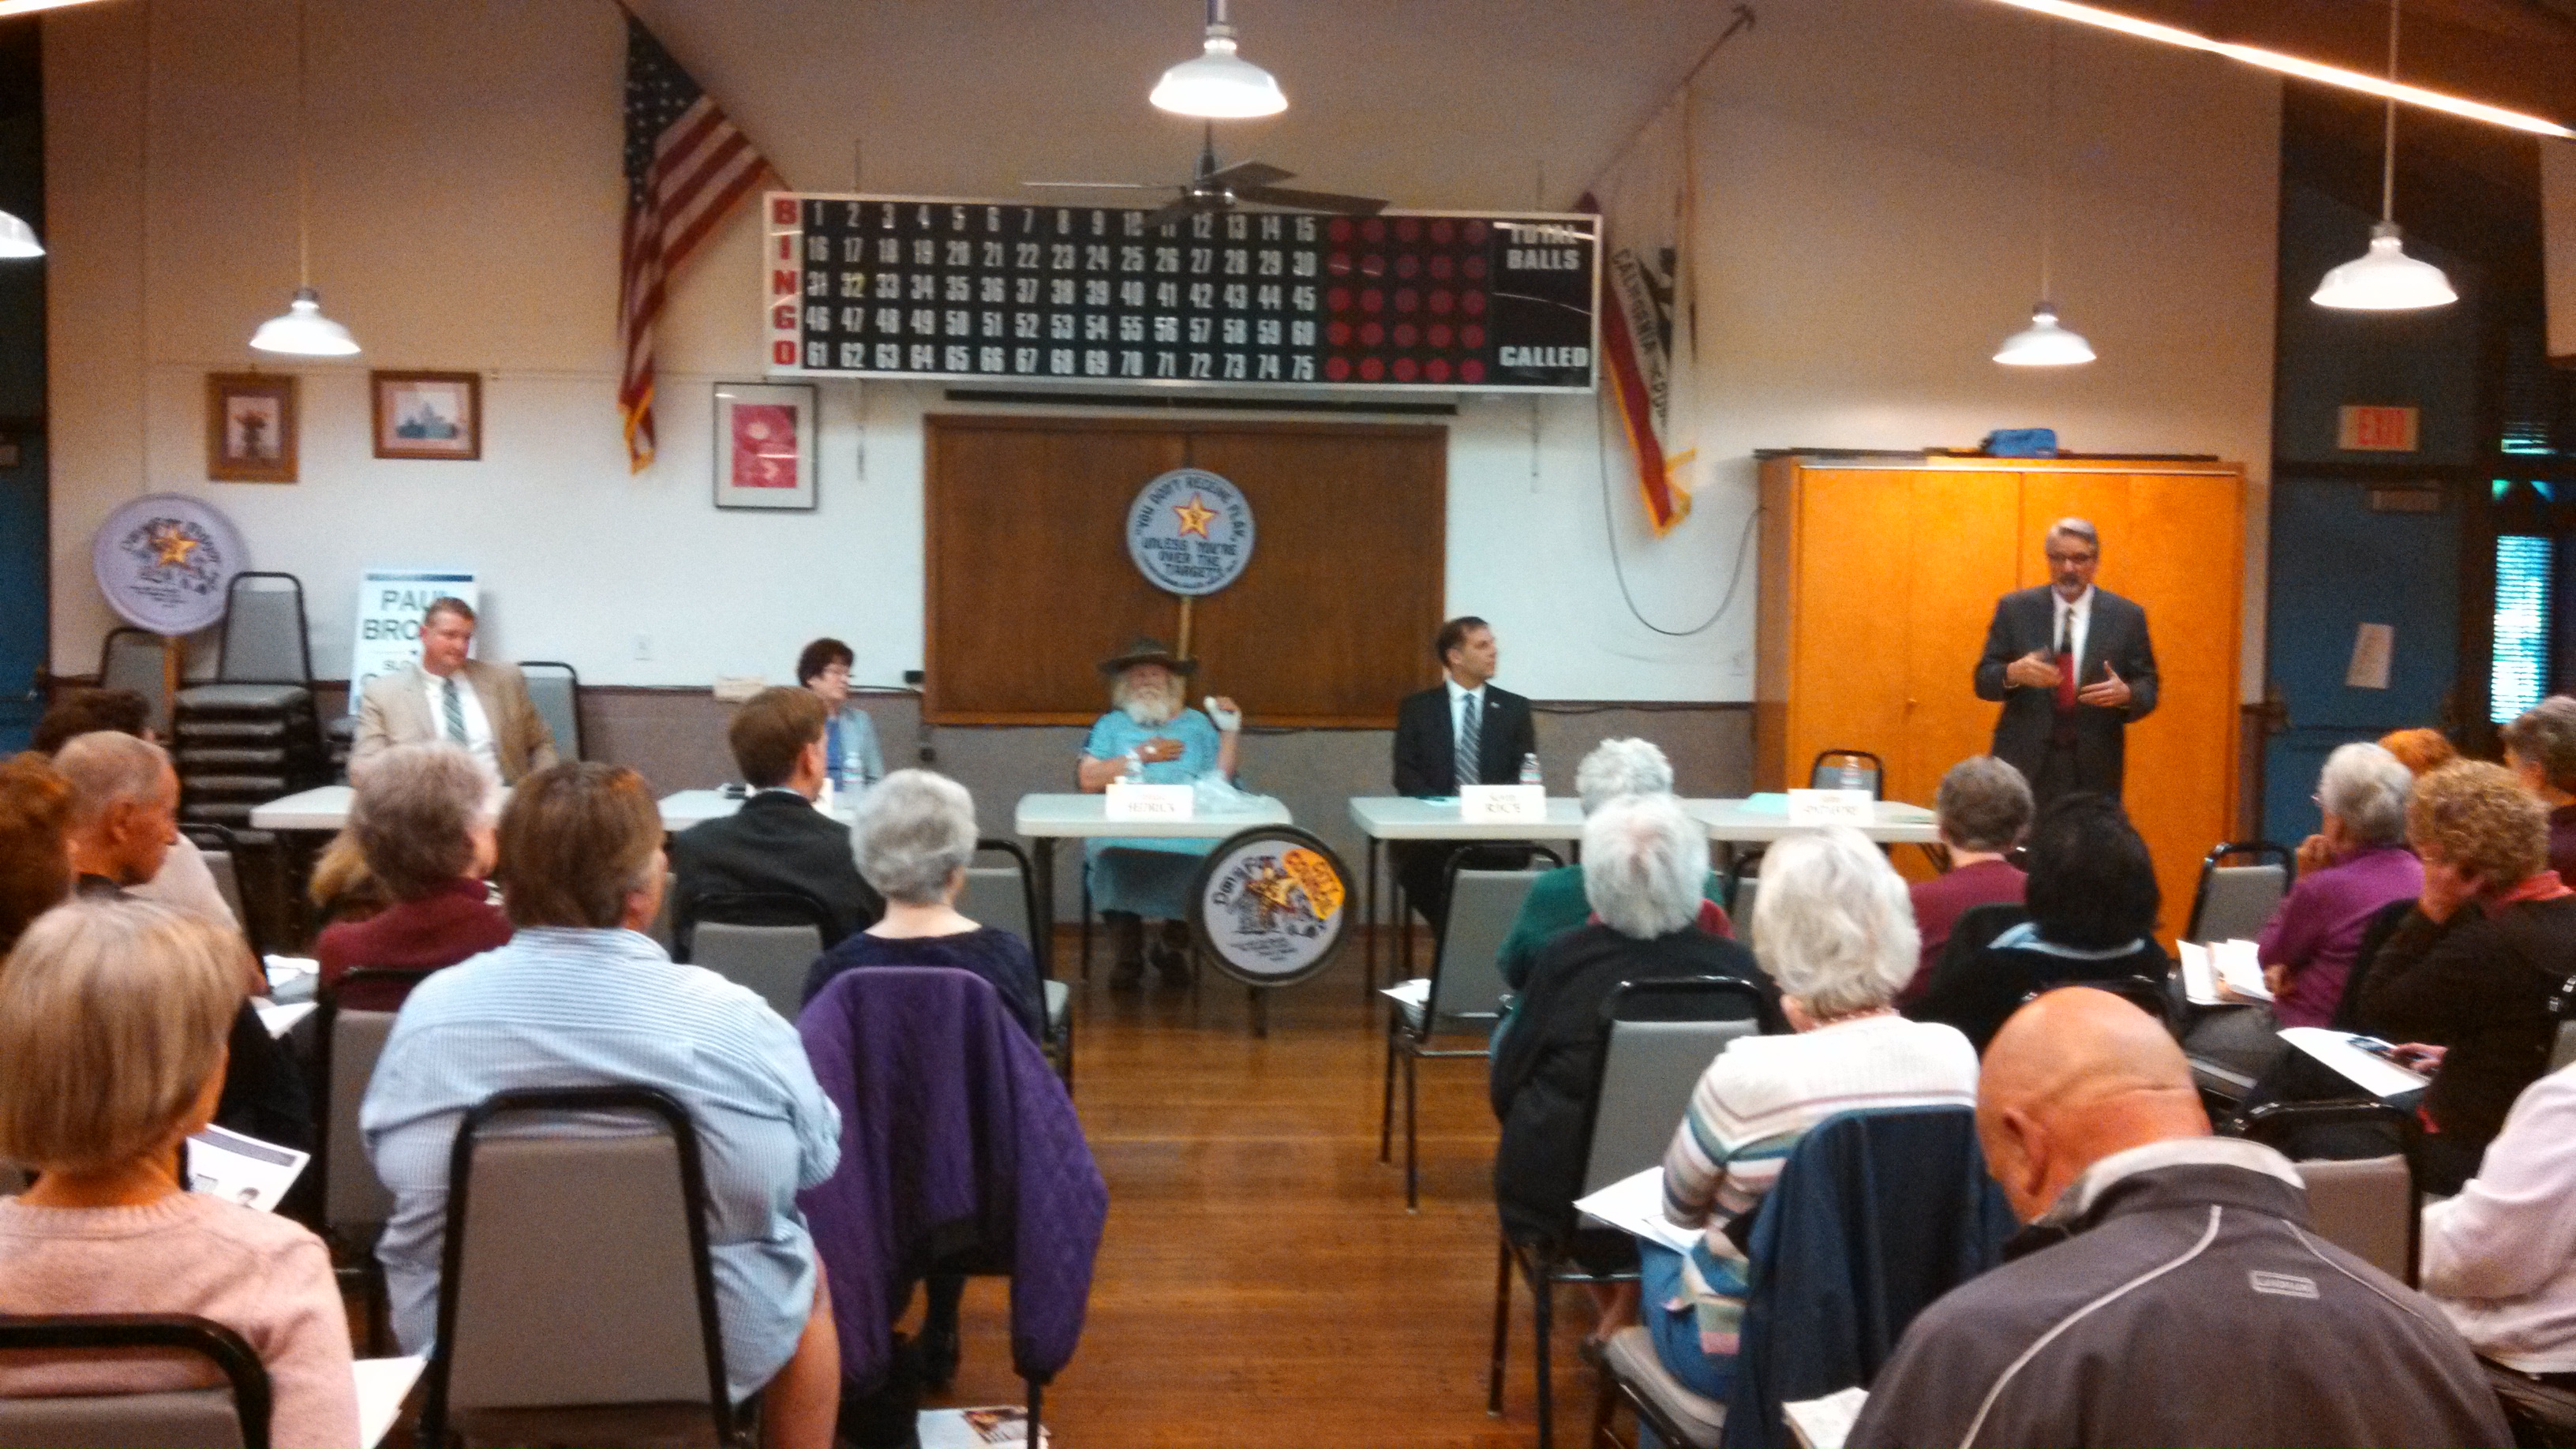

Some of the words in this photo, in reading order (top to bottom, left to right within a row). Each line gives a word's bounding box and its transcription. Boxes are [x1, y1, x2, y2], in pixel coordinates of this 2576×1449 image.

[807, 236, 829, 262] 16
[844, 237, 863, 262] 17
[879, 238, 899, 264] 18
[914, 240, 934, 264] 19
[947, 241, 970, 265] 20
[983, 242, 1003, 267] 21
[1017, 242, 1039, 268] 22
[1052, 244, 1075, 270] 23
[1087, 245, 1109, 270] 24
[1121, 246, 1144, 271] 25
[1156, 247, 1178, 272] 26
[1191, 248, 1212, 274] 27
[1225, 249, 1247, 275] 28
[1260, 250, 1282, 275] 29
[1293, 251, 1316, 277] 30
[1507, 249, 1581, 270] BALLS
[807, 271, 828, 298] 31
[841, 272, 864, 298] 32
[876, 273, 900, 298] 33
[911, 275, 934, 299] 34
[946, 275, 969, 301] 35
[981, 277, 1005, 302] 36
[1017, 278, 1039, 303] 37
[1052, 279, 1074, 304] 38
[1086, 280, 1109, 305] 39
[1121, 281, 1144, 306] 40
[1157, 282, 1177, 307] 41
[1189, 283, 1213, 309] 42
[1224, 284, 1247, 309] 43
[1258, 285, 1281, 309] 44
[1293, 286, 1316, 311] 45
[805, 306, 829, 332] 46
[841, 307, 863, 332] 47
[876, 309, 900, 333] 48
[911, 309, 934, 335] 49
[946, 310, 969, 335] 50
[983, 312, 1002, 336] 51
[1016, 313, 1039, 338] 52
[1051, 314, 1074, 339] 53
[1086, 315, 1109, 340] 54
[1121, 316, 1144, 341] 55
[1155, 316, 1178, 342] 56
[1189, 317, 1211, 343] 57
[1224, 319, 1246, 344] 58
[1258, 320, 1281, 345] 59
[1292, 320, 1315, 346] 60
[807, 342, 829, 368] 61
[840, 343, 864, 369] 62
[875, 343, 900, 369] 63
[910, 344, 934, 370] 64
[945, 346, 969, 373] 65
[980, 346, 1004, 373] 66
[1016, 348, 1038, 375] 67
[1051, 349, 1074, 376] 68
[1085, 350, 1109, 377] 69
[1121, 351, 1143, 378] 70
[1158, 351, 1175, 378] 71
[1190, 353, 1211, 380] 72
[1224, 354, 1245, 380] 73
[1259, 354, 1279, 381] 74
[1293, 355, 1314, 382] 75
[1500, 346, 1589, 367] CALLED
[382, 590, 447, 611] PAU
